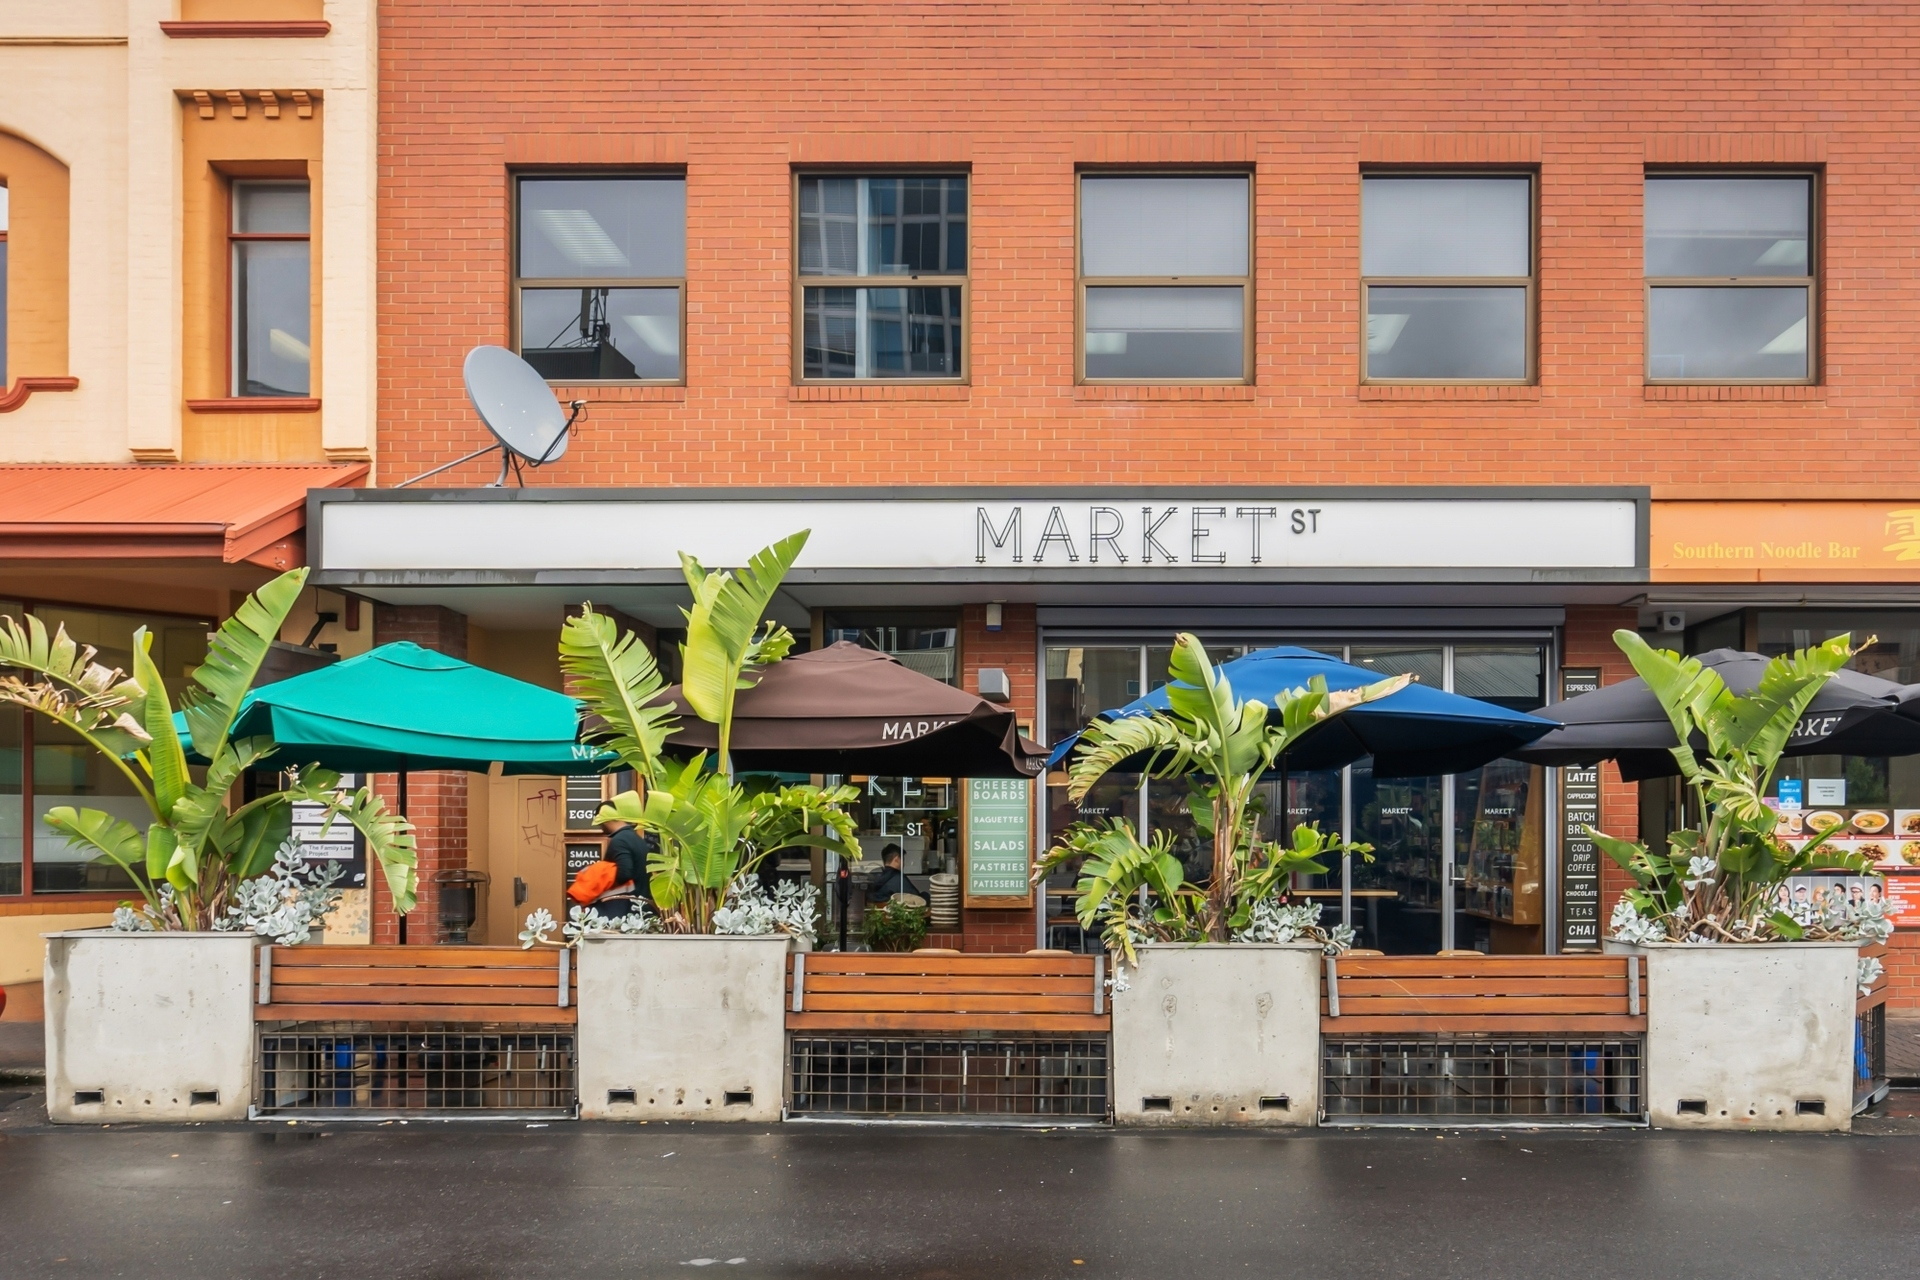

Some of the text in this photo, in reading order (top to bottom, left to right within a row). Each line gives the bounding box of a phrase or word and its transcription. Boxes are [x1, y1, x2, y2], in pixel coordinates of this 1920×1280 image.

[975, 506, 1322, 563] MARKET ST
[1673, 541, 1861, 559] Southern Noodle Bar
[1566, 684, 1597, 692] ESPRESSO
[882, 721, 957, 740] MARK
[1790, 717, 1842, 738] RKE
[1567, 772, 1597, 782] LATTE
[973, 780, 1025, 790] CHEESE
[973, 791, 1025, 800] BOARDS
[569, 809, 597, 820] EGG
[1078, 807, 1105, 815] MARKET
[1381, 807, 1409, 815] MARKET
[1484, 807, 1512, 815] MARKET
[974, 816, 1024, 824] BAGUETTES
[1567, 812, 1595, 822] BATCH
[906, 822, 924, 836] ST
[973, 840, 1025, 851] SALADS
[1571, 843, 1592, 853] COLD
[570, 850, 600, 859] SMALL
[1573, 854, 1591, 862] DRIP
[973, 863, 1025, 872] PASTRIES
[1567, 863, 1597, 873] COFFEE
[973, 880, 1025, 888] PATISSERIE
[1570, 907, 1594, 917] TEAS
[1568, 925, 1596, 936] CHAI
